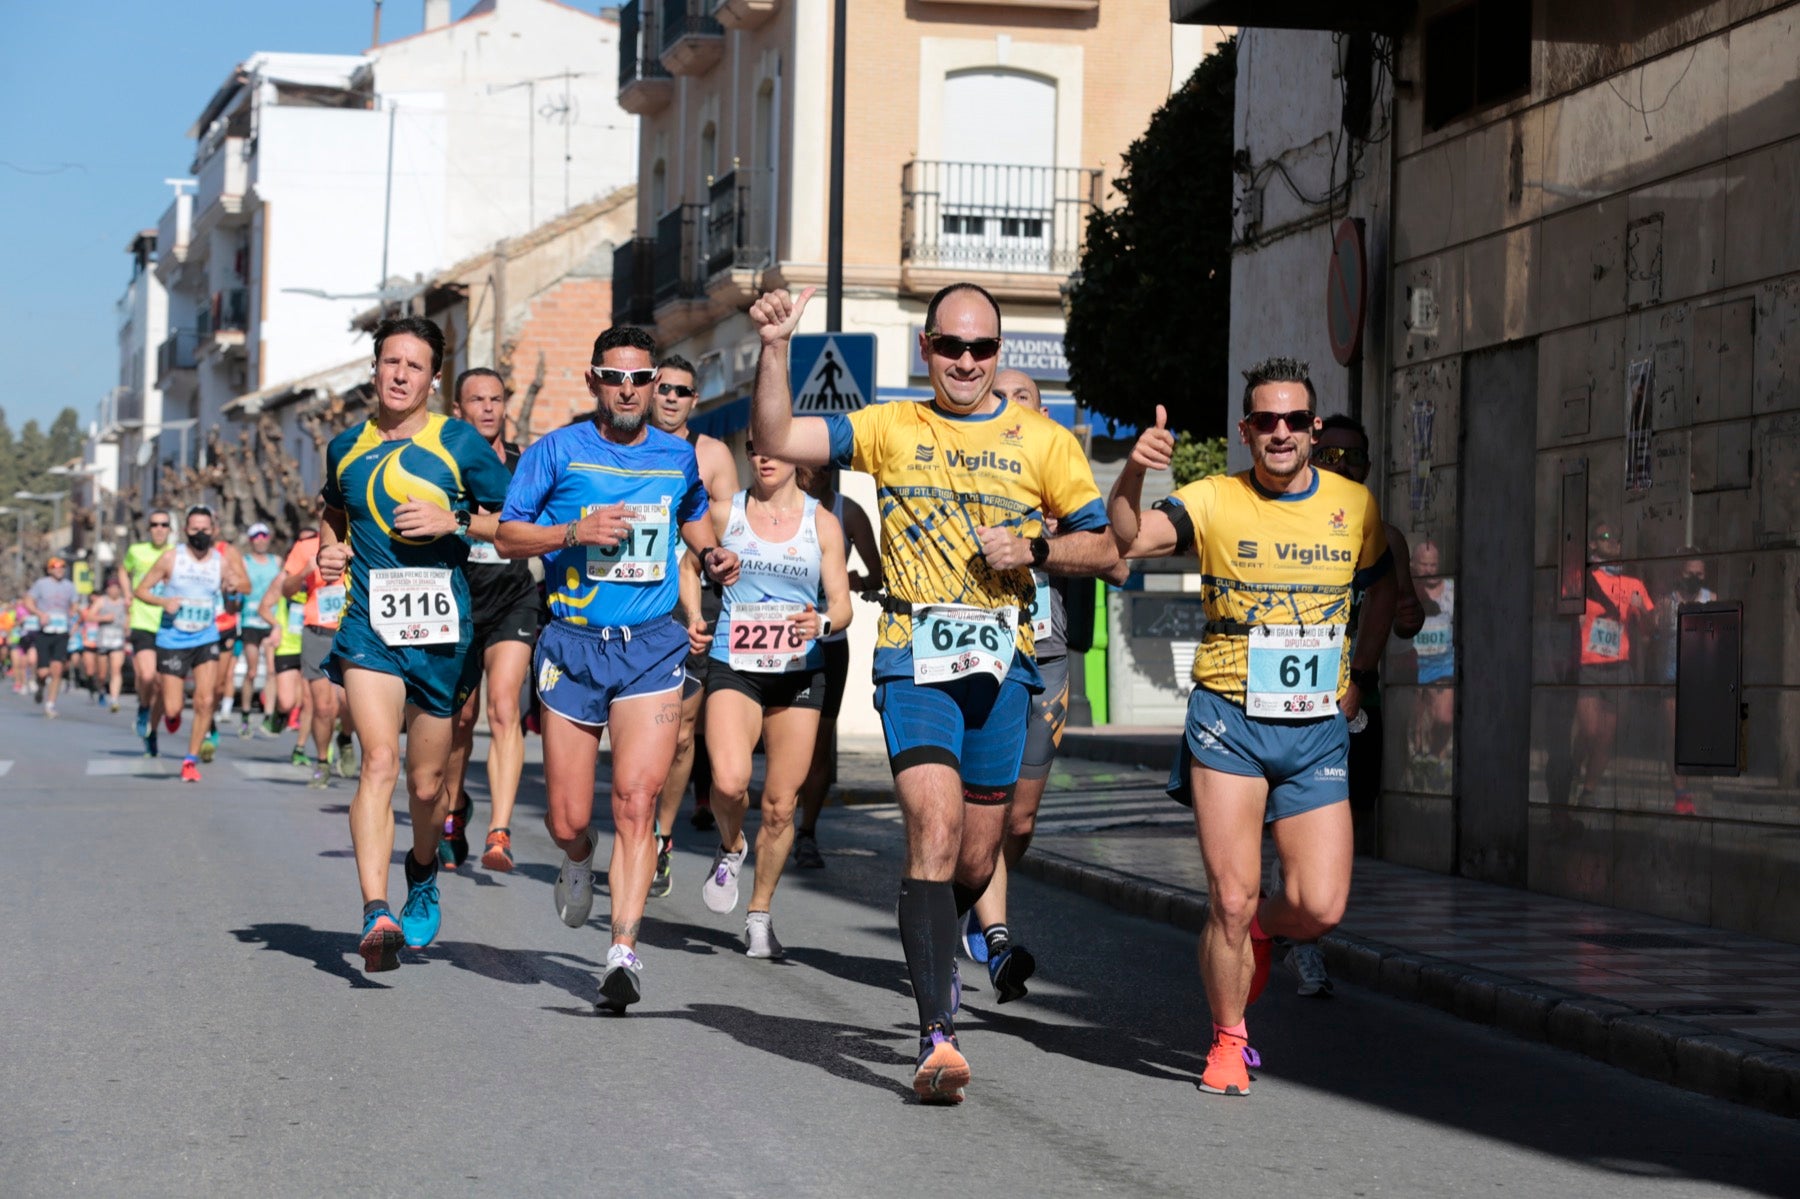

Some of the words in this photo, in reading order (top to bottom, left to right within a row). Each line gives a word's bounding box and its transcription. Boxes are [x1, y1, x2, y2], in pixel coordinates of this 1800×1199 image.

[945, 449, 1022, 475] Vigilsa
[1275, 543, 1352, 565] Vigilsa
[1215, 578, 1236, 588] CLUB
[1296, 585, 1313, 593] LOS
[381, 592, 451, 618] 3116
[734, 625, 803, 649] 2278
[931, 619, 999, 651] 626
[1276, 628, 1293, 637] GRAN
[1318, 628, 1324, 636] DE
[1284, 638, 1320, 648] DIPUTACIÓN
[1279, 654, 1319, 688] 61
